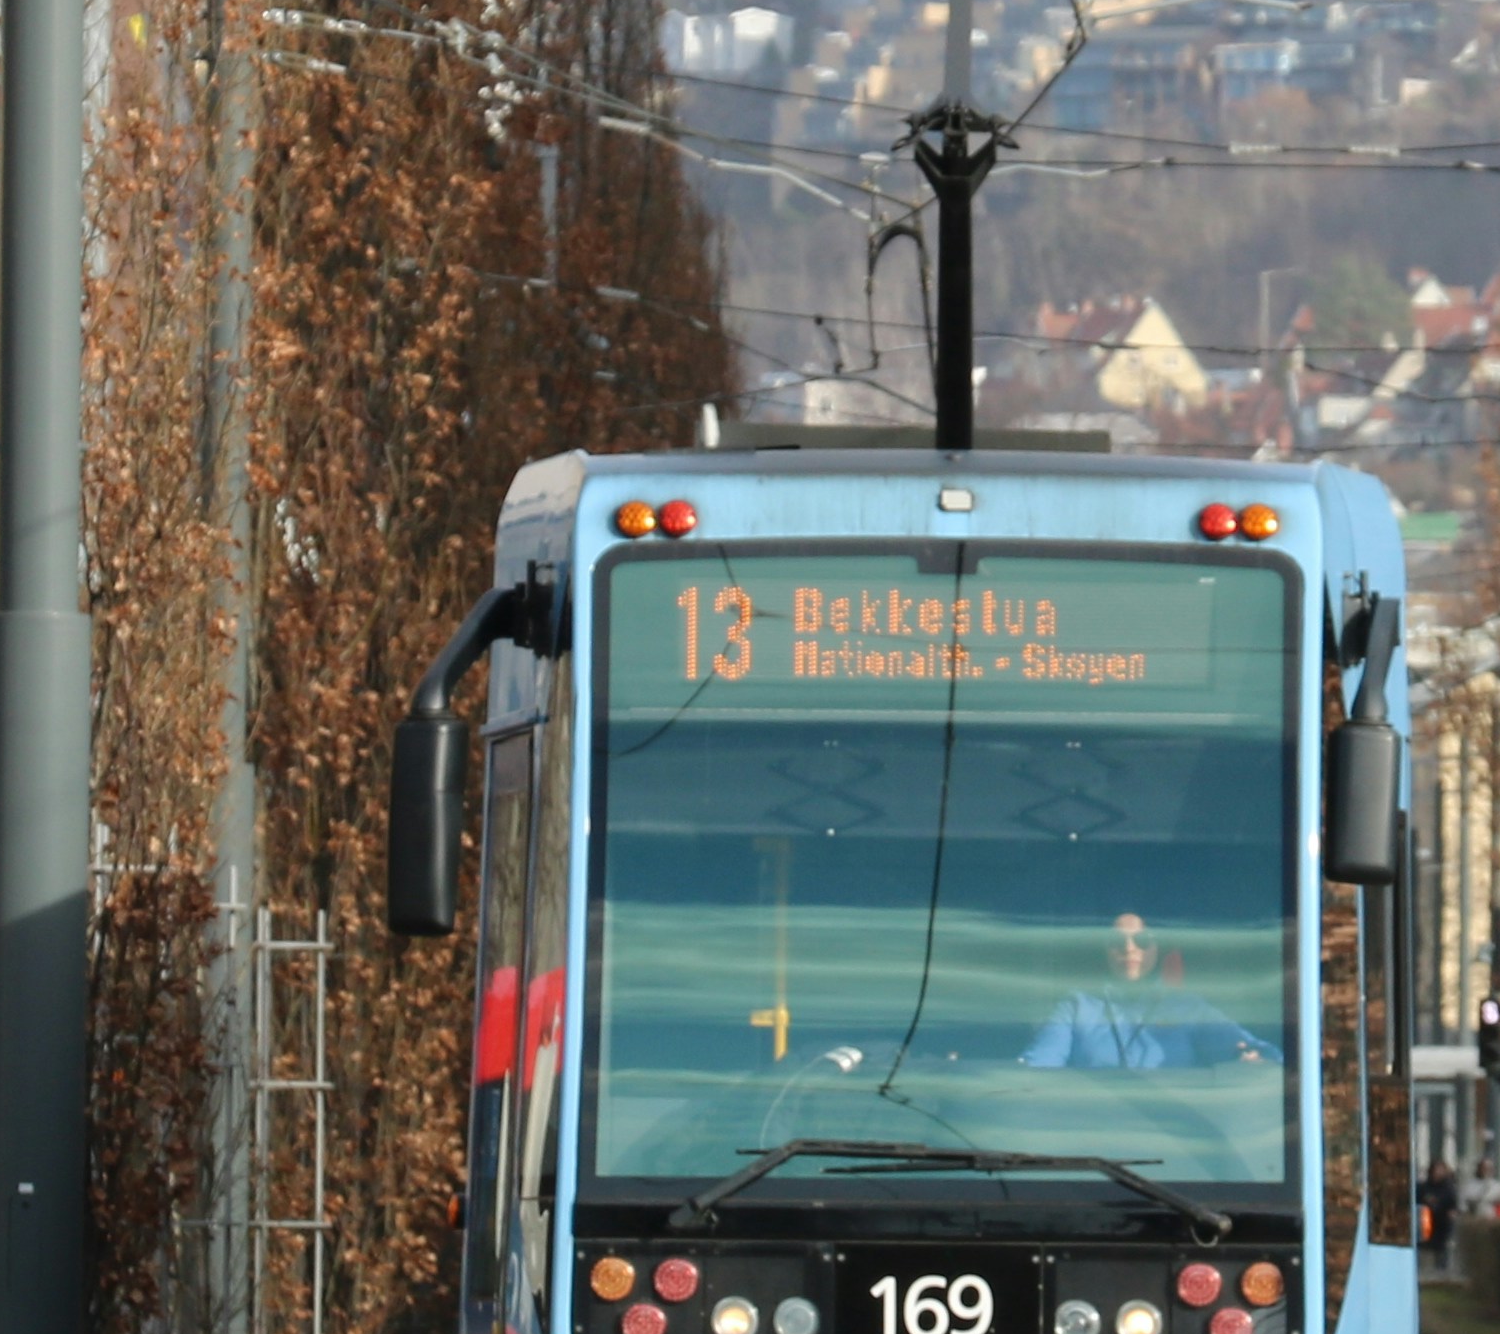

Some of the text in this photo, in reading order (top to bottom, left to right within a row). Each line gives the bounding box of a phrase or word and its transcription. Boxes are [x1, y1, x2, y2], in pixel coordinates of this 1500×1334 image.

[677, 586, 751, 680] 13
[794, 587, 1056, 636] Bekkestua
[794, 640, 984, 679] Nationalth.
